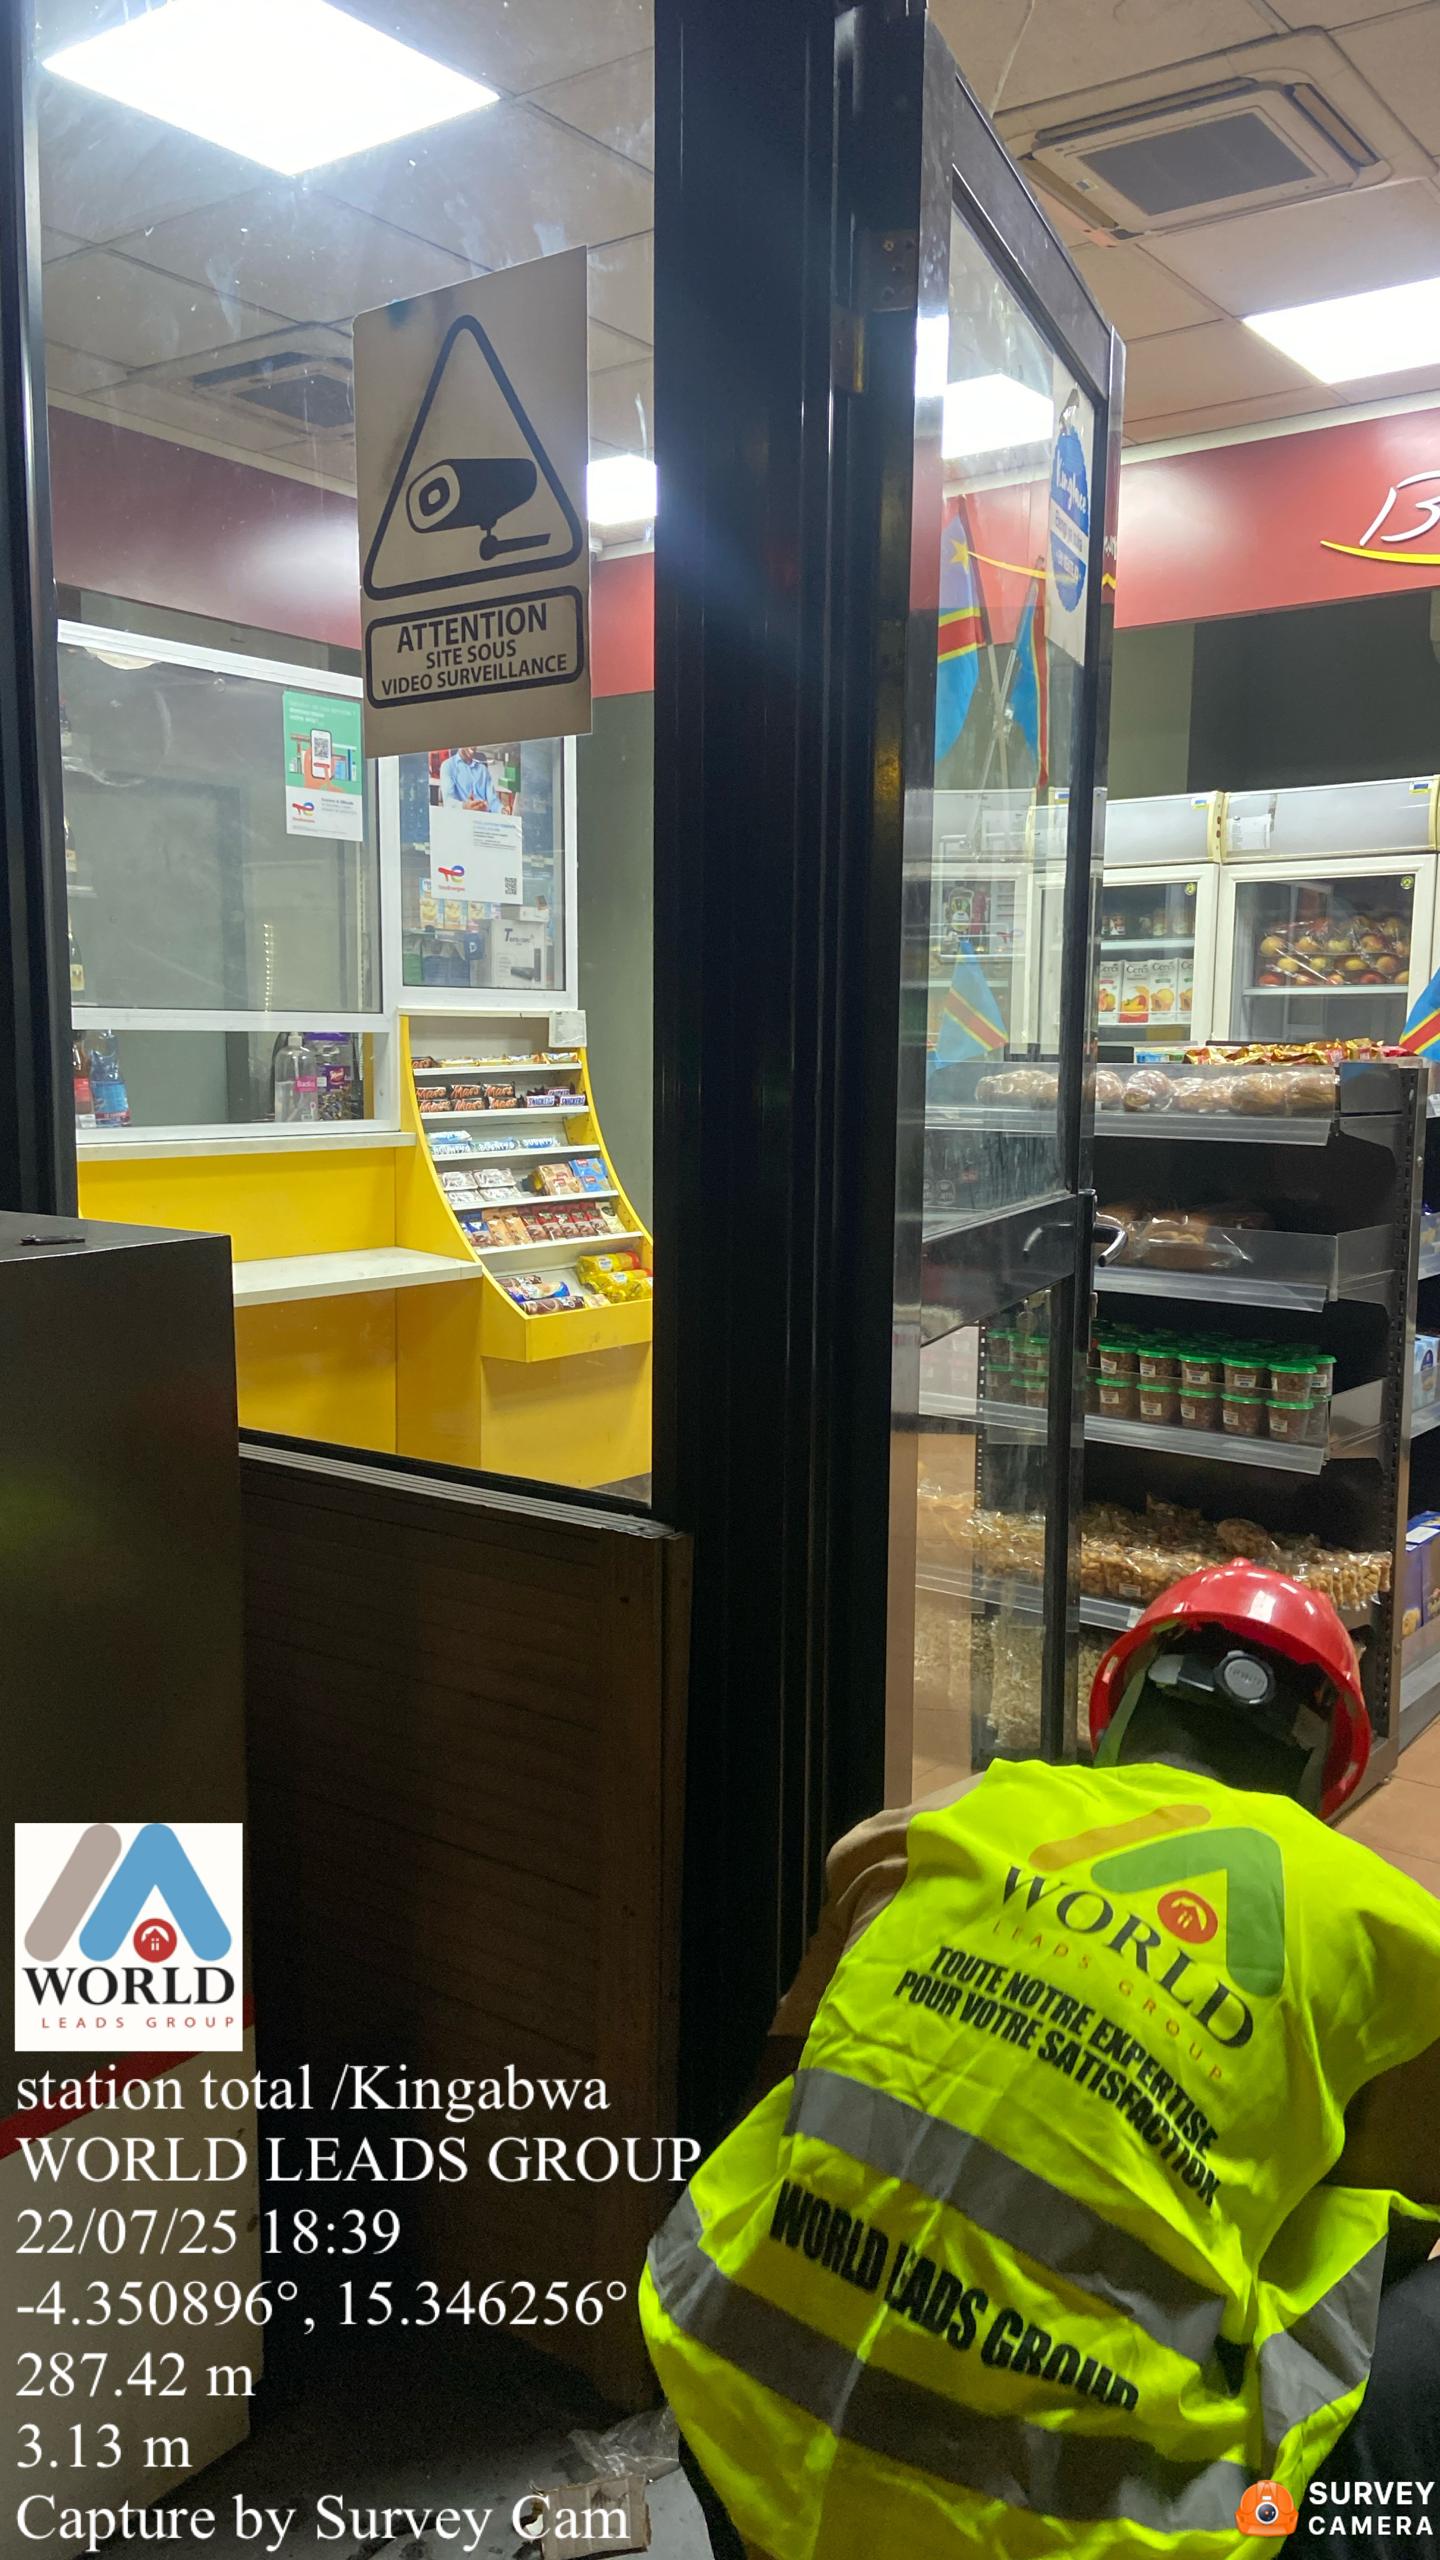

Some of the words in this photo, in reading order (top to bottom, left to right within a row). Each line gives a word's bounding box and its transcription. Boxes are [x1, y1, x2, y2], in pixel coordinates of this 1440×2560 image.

[397, 603, 547, 653] ATTENTION
[382, 673, 432, 696] VIDEO
[437, 654, 567, 688] SURVEILLANCE
[426, 648, 462, 669] SITE
[467, 639, 516, 663] SOUS
[452, 1085, 481, 1098] Mars
[455, 1099, 485, 1111] Mars
[485, 1086, 513, 1097] Mars
[1003, 1865, 1254, 2048] WORLD
[929, 1945, 1009, 1994] TOUTE
[1001, 1968, 1097, 2036] NOTRE
[1088, 2017, 1218, 2151] EXPERTISE
[1118, 1979, 1222, 2080] GROUP
[893, 1969, 964, 2016] POUR
[959, 1990, 1044, 2050] VOTRE
[1037, 2029, 1220, 2207] SATISFACTION
[770, 2178, 889, 2294] WORLD
